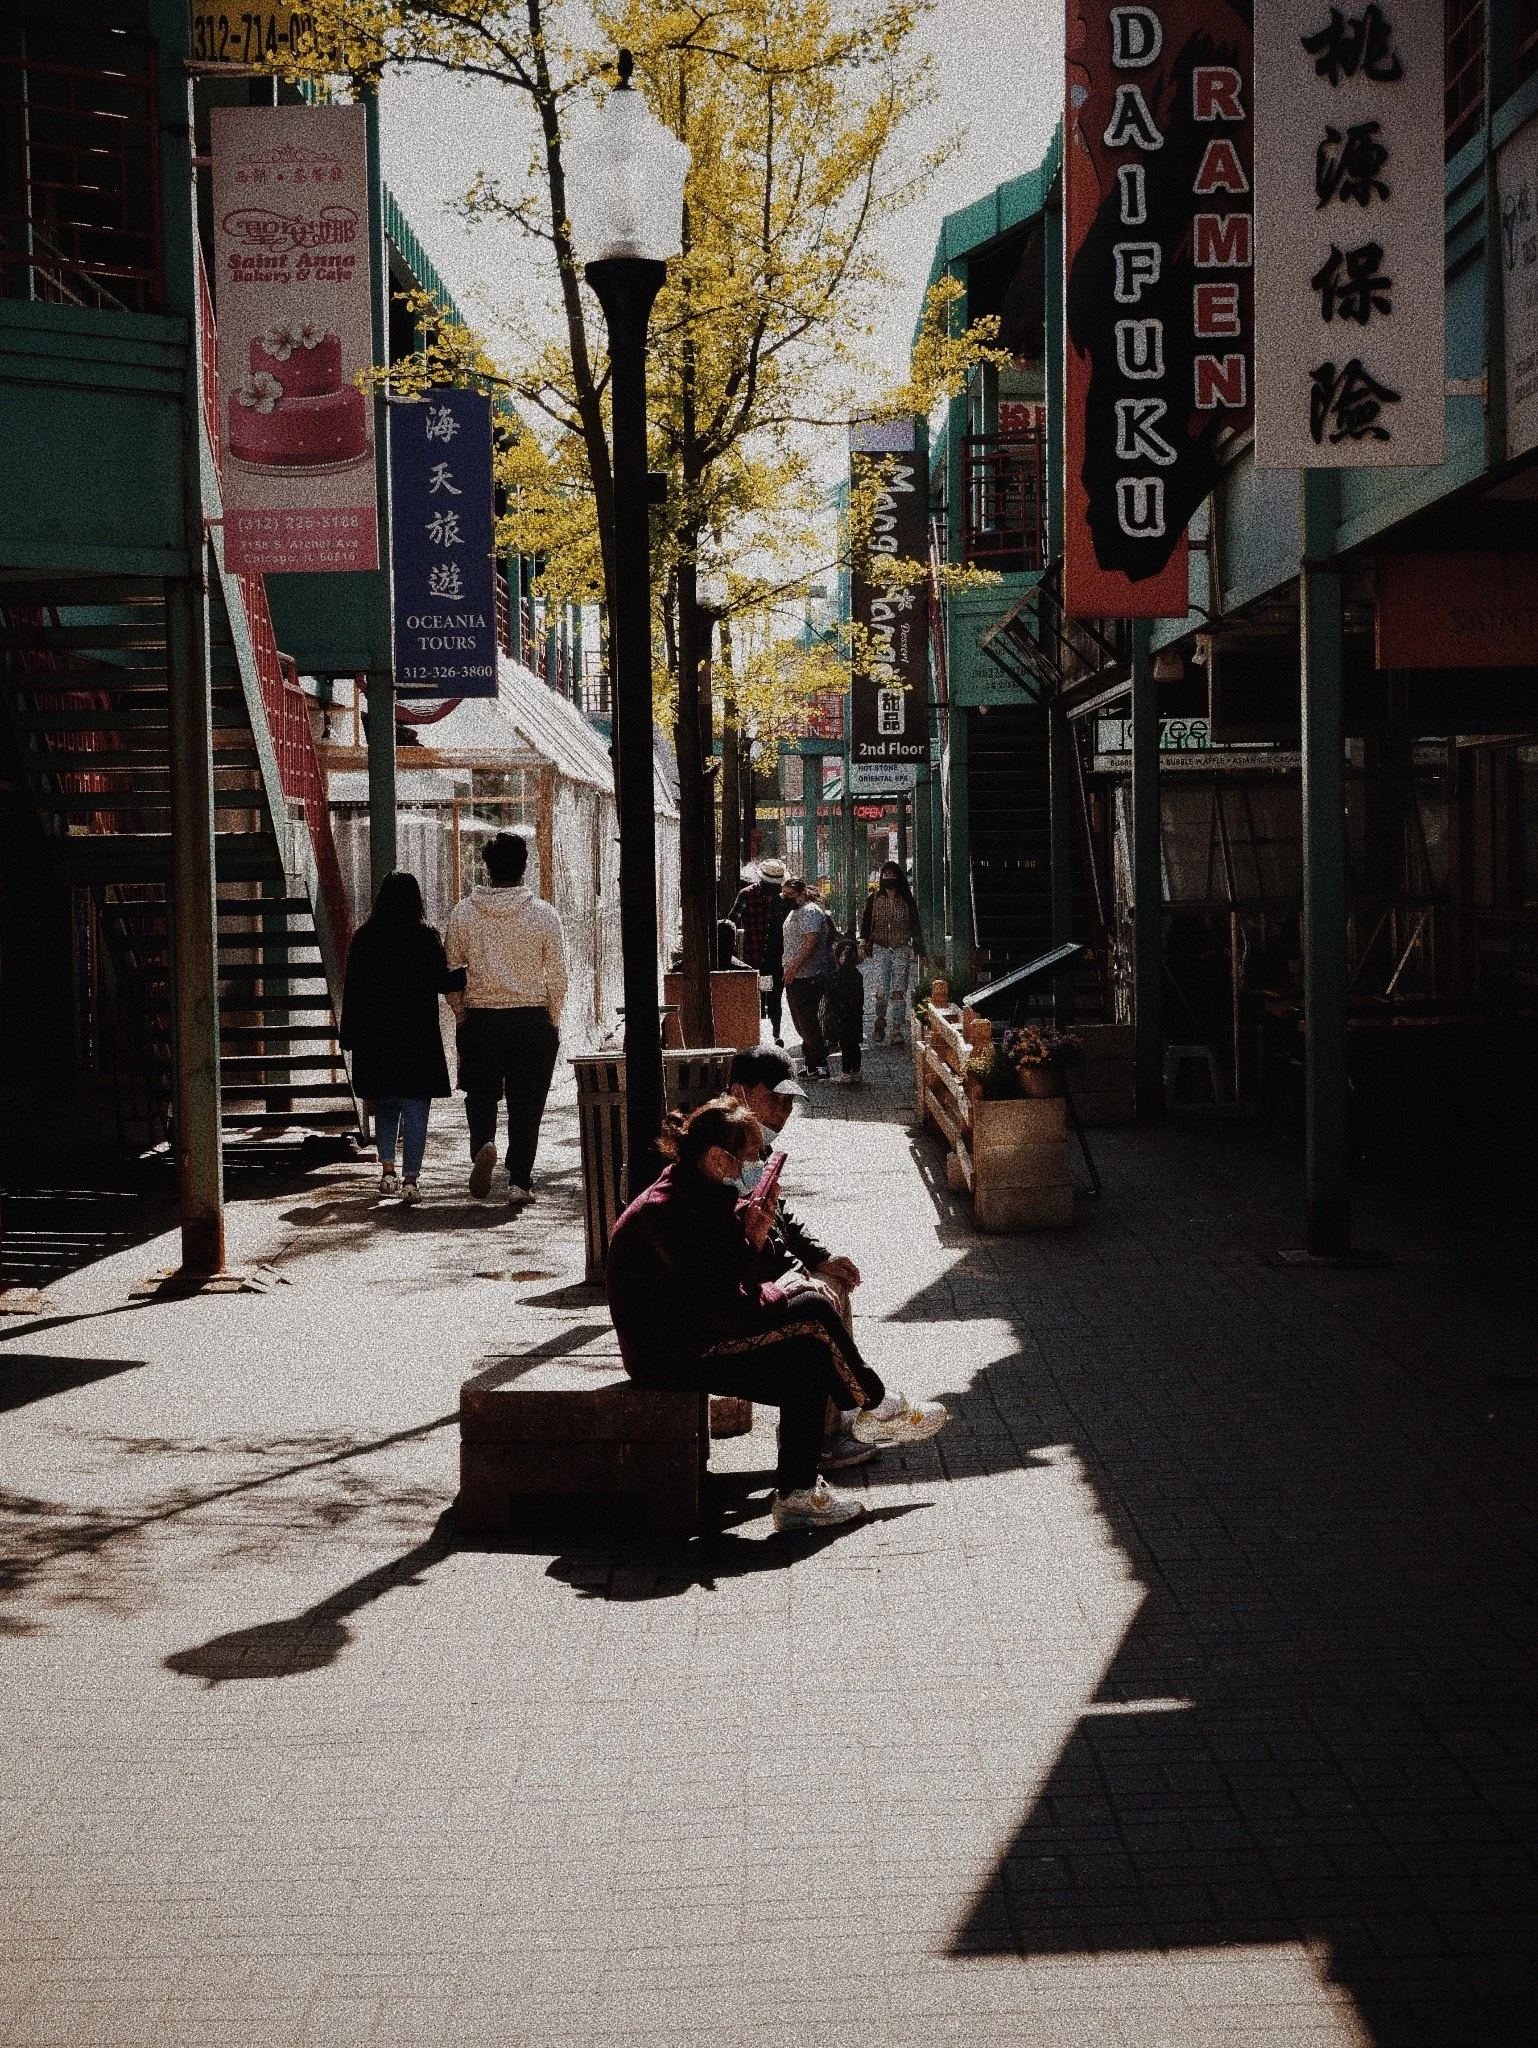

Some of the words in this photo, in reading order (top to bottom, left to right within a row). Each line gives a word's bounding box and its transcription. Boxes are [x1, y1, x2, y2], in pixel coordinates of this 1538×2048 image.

[1300, 3, 1404, 447] 桃源保險
[1192, 66, 1253, 410] RAMEN
[227, 253, 289, 269] Saint
[295, 252, 356, 268] Anna
[232, 269, 292, 284] Bakery
[296, 268, 311, 281] &
[315, 267, 353, 282] Cafe
[1102, 4, 1179, 540] DAIFUKU
[424, 405, 466, 601] 海天旅遊
[405, 613, 487, 630] OCEANIA
[417, 635, 478, 652] TOURS
[403, 664, 494, 680] 312-326-3800
[858, 742, 885, 756] 2nd
[889, 741, 925, 756] Floor
